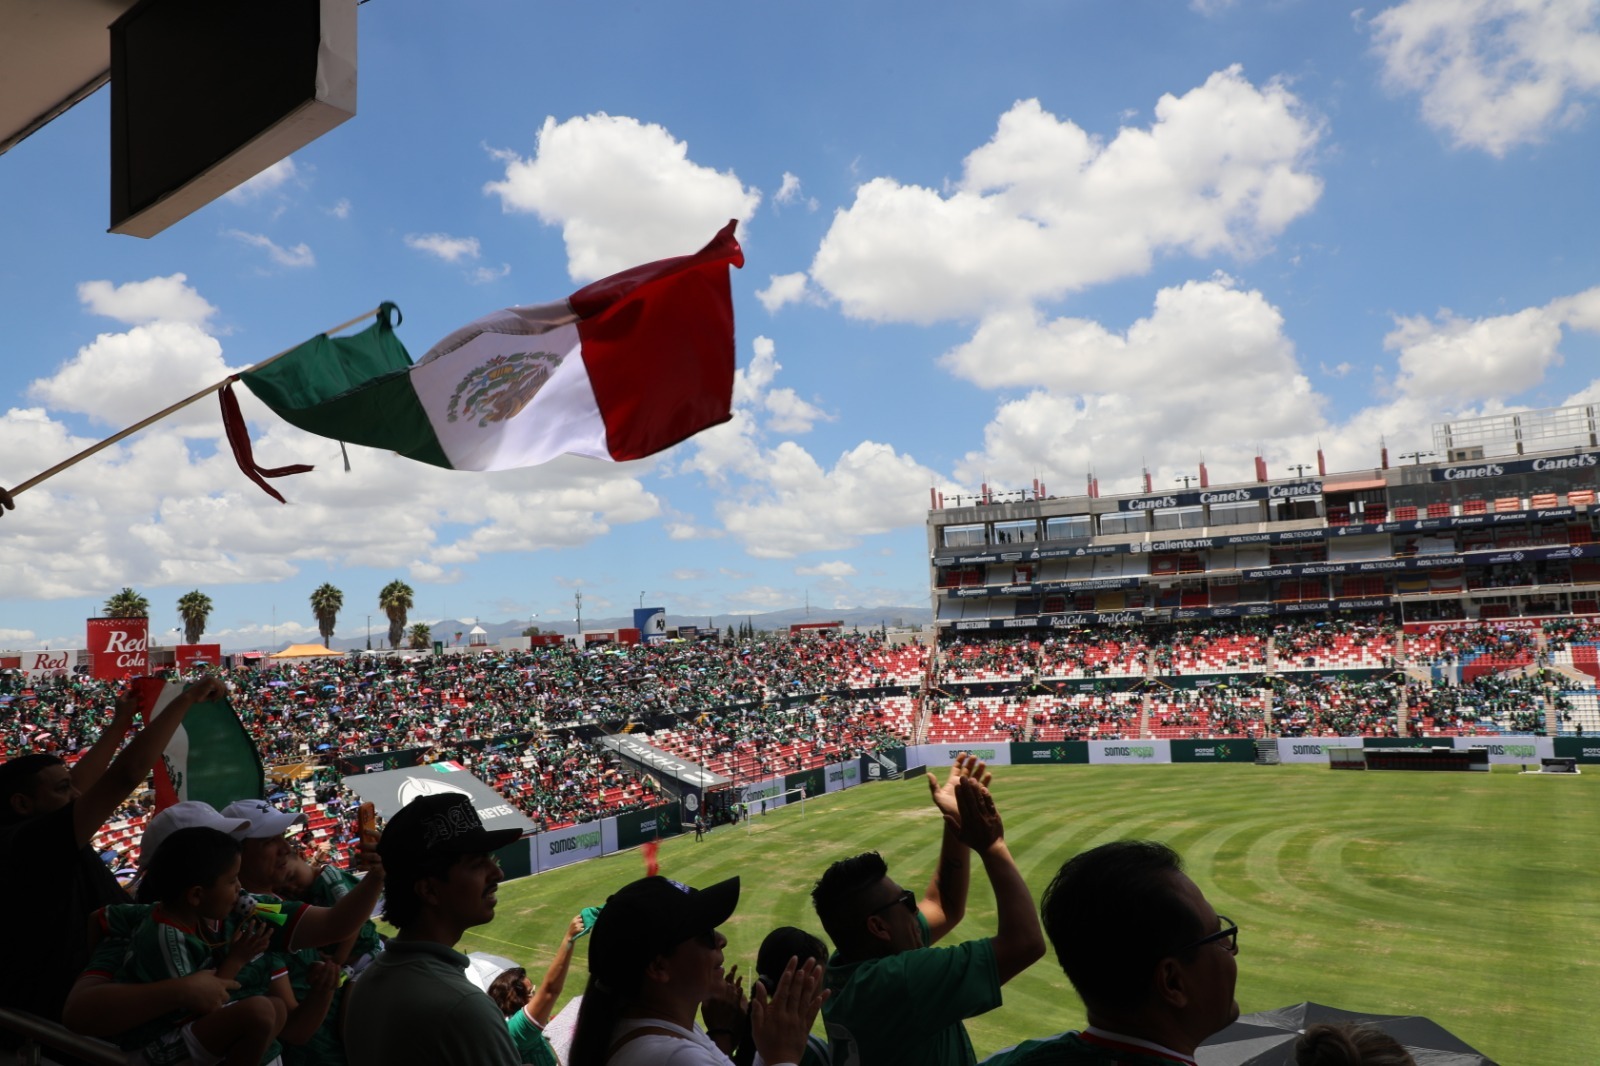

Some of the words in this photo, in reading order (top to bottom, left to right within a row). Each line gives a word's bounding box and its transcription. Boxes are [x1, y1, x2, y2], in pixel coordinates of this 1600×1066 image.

[1532, 453, 1596, 471] Canel's
[1444, 464, 1504, 480] Canel's
[1200, 488, 1251, 503] Canel's
[1270, 482, 1322, 498] Canel's
[1128, 496, 1177, 510] Canel's
[1457, 517, 1484, 525] DAIKIN
[1500, 513, 1527, 521] DAIKIN
[1545, 509, 1572, 518] DAIKIN
[1153, 538, 1213, 551] caliente.mx
[103, 629, 148, 653] Red
[33, 651, 69, 670] Red
[116, 651, 145, 668] Cola
[476, 804, 514, 820] REYES
